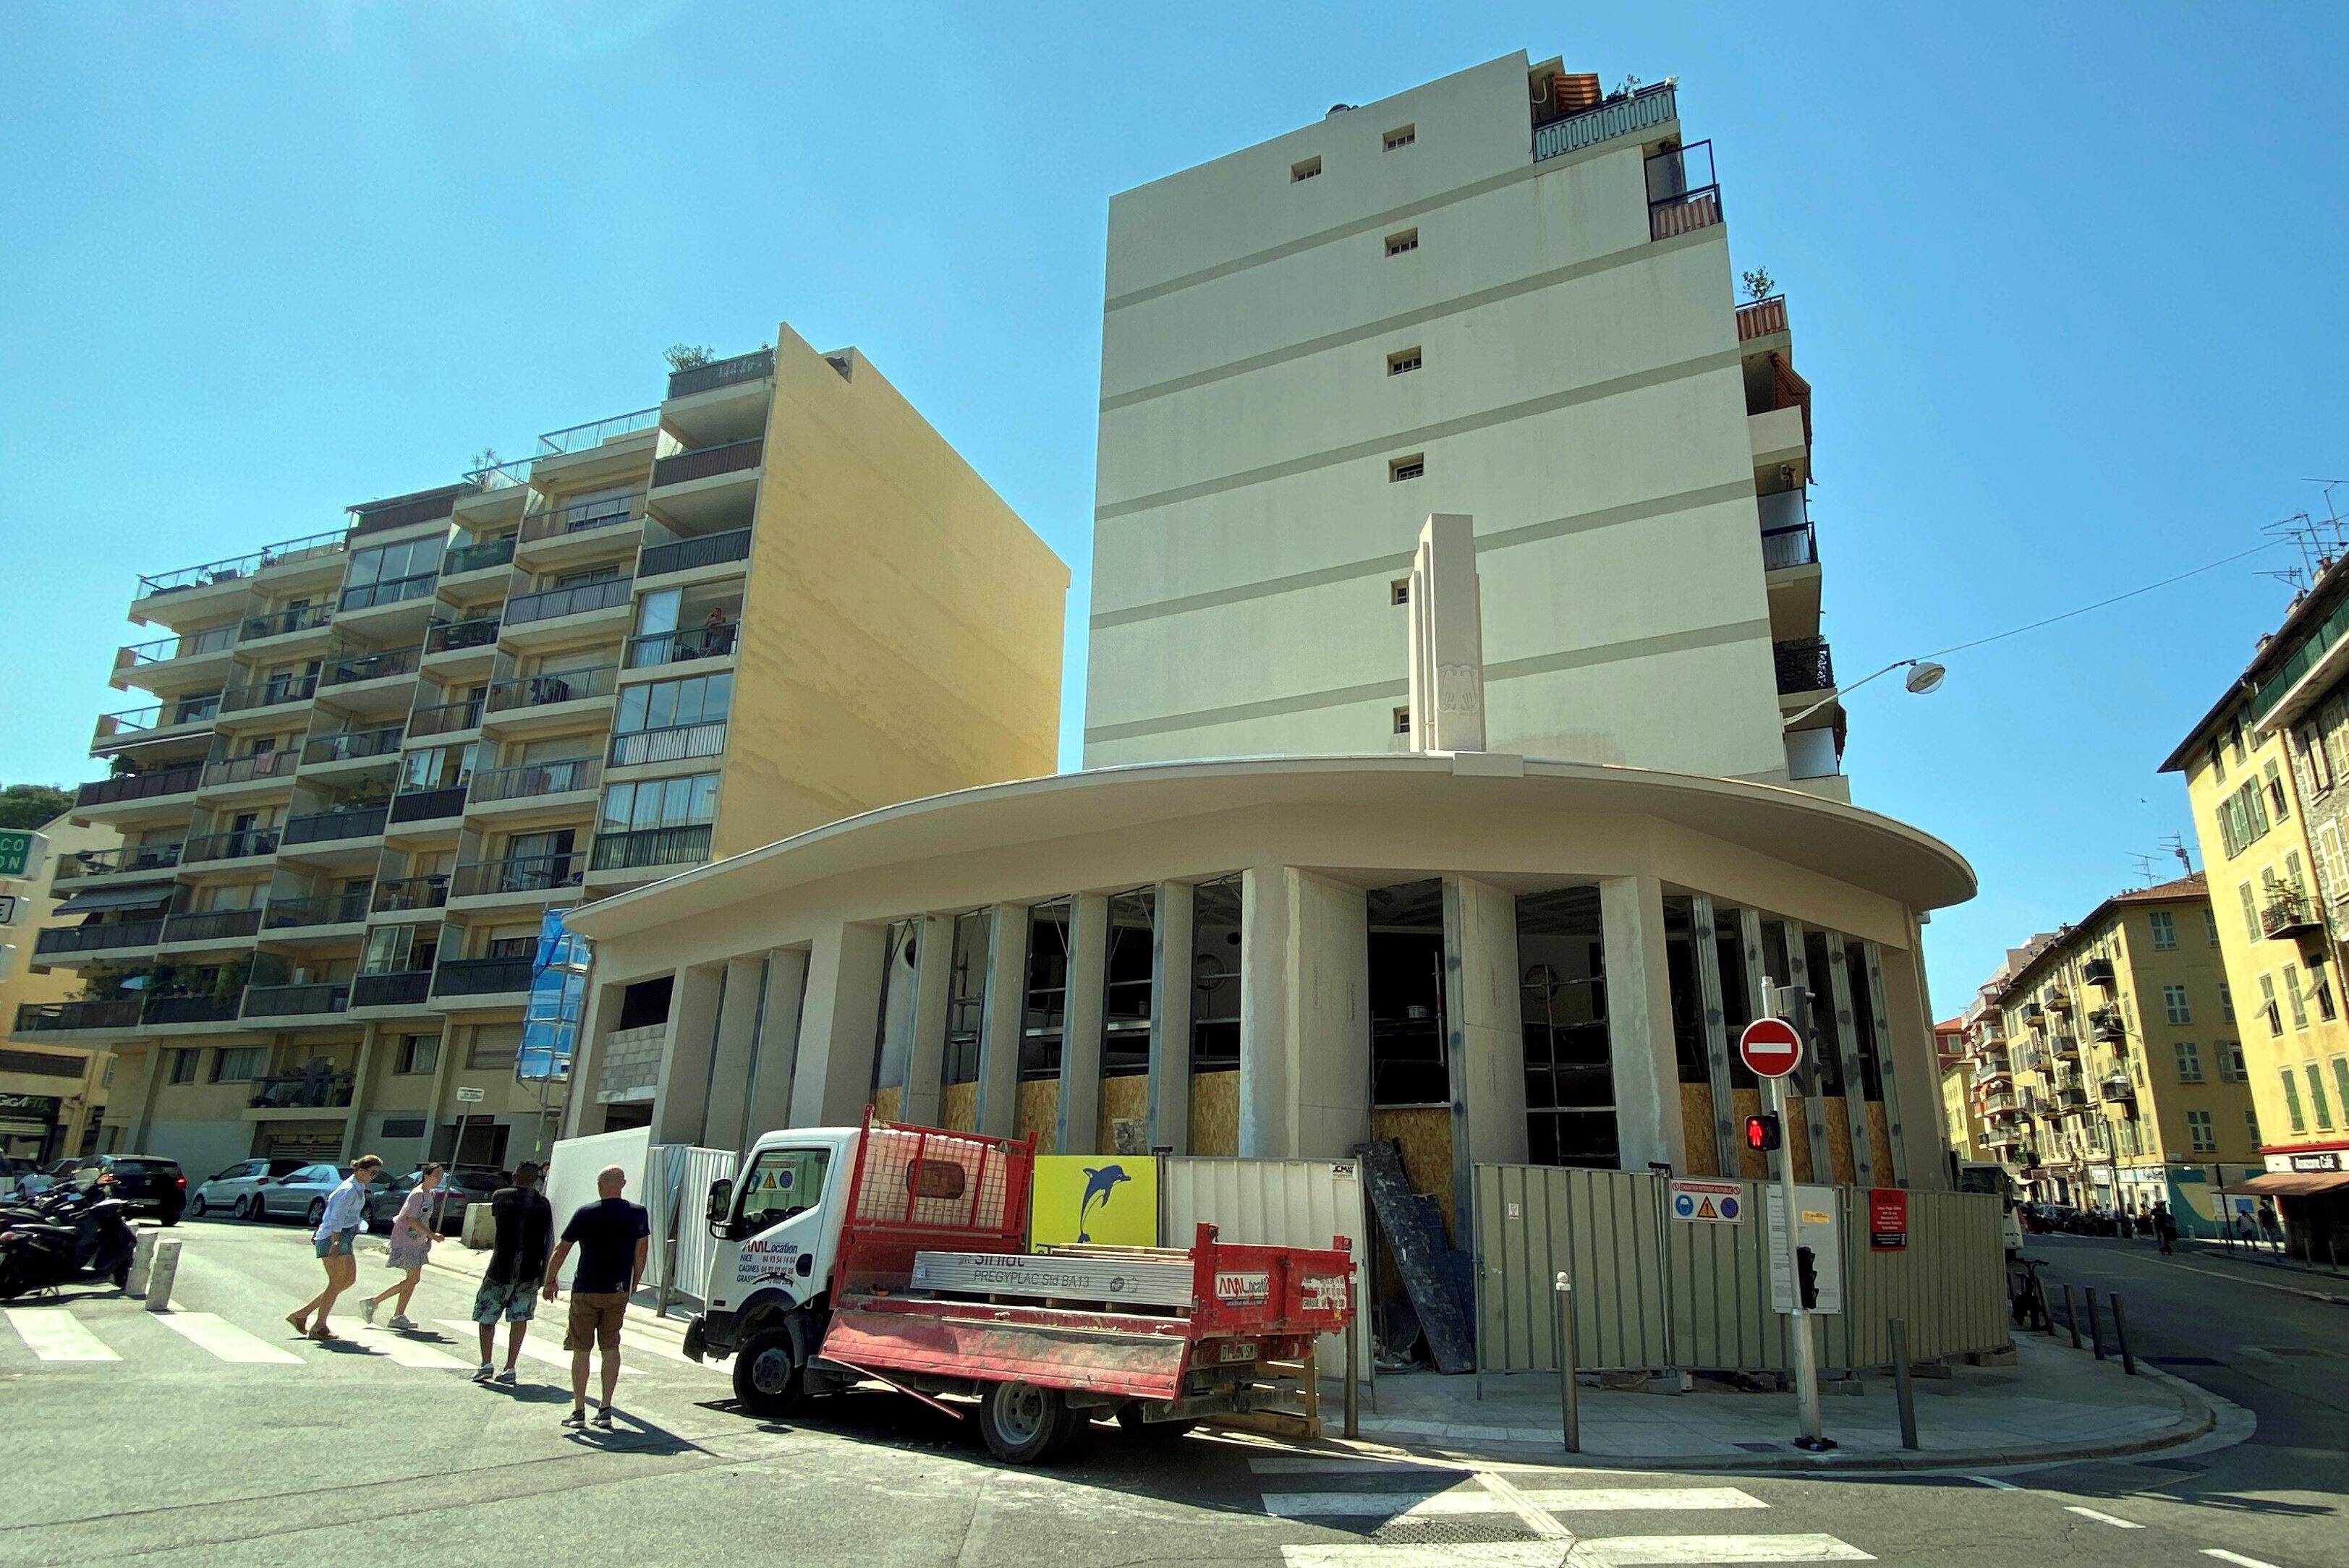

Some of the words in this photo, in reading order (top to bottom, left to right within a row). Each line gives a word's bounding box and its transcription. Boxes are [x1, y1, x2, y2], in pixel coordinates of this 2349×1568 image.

[739, 1264, 760, 1273] CAGNES
[974, 1270, 1040, 1285] PREGYPLAC
[1042, 1273, 1058, 1286] Std
[1062, 1274, 1089, 1287] BA13
